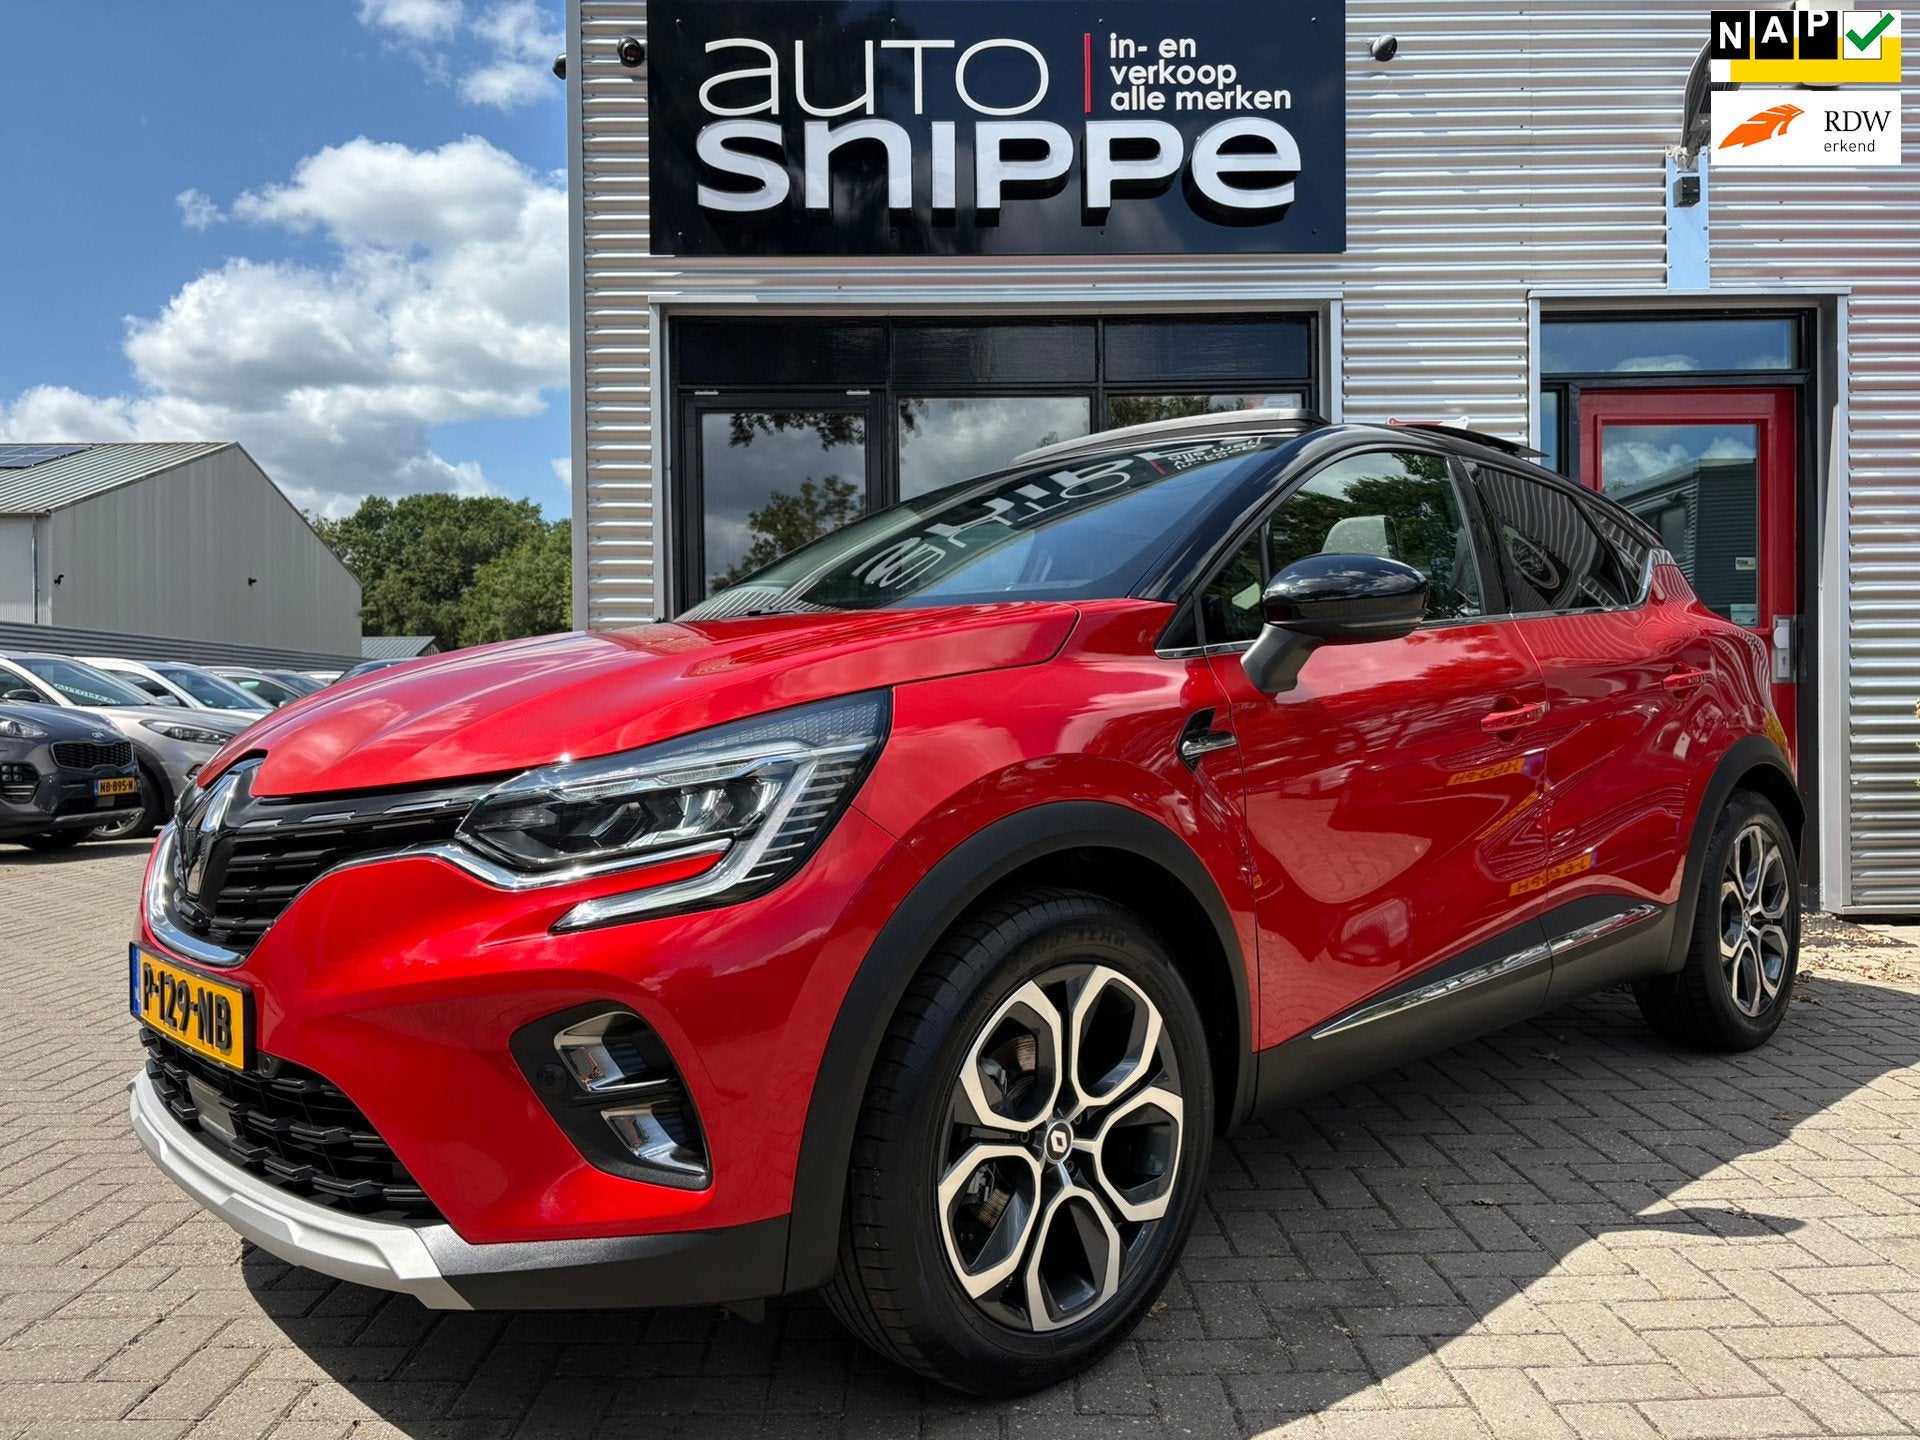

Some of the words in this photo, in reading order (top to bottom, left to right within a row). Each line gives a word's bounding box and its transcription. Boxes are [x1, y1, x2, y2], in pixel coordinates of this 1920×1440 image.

[1109, 32, 1148, 59] in-
[1157, 36, 1197, 59] en
[1109, 60, 1237, 90] verkoop
[1109, 85, 1163, 111] alle
[1175, 85, 1292, 111] merken
[100, 779, 133, 793] NB-895-N
[143, 961, 232, 1051] P-129-NB
